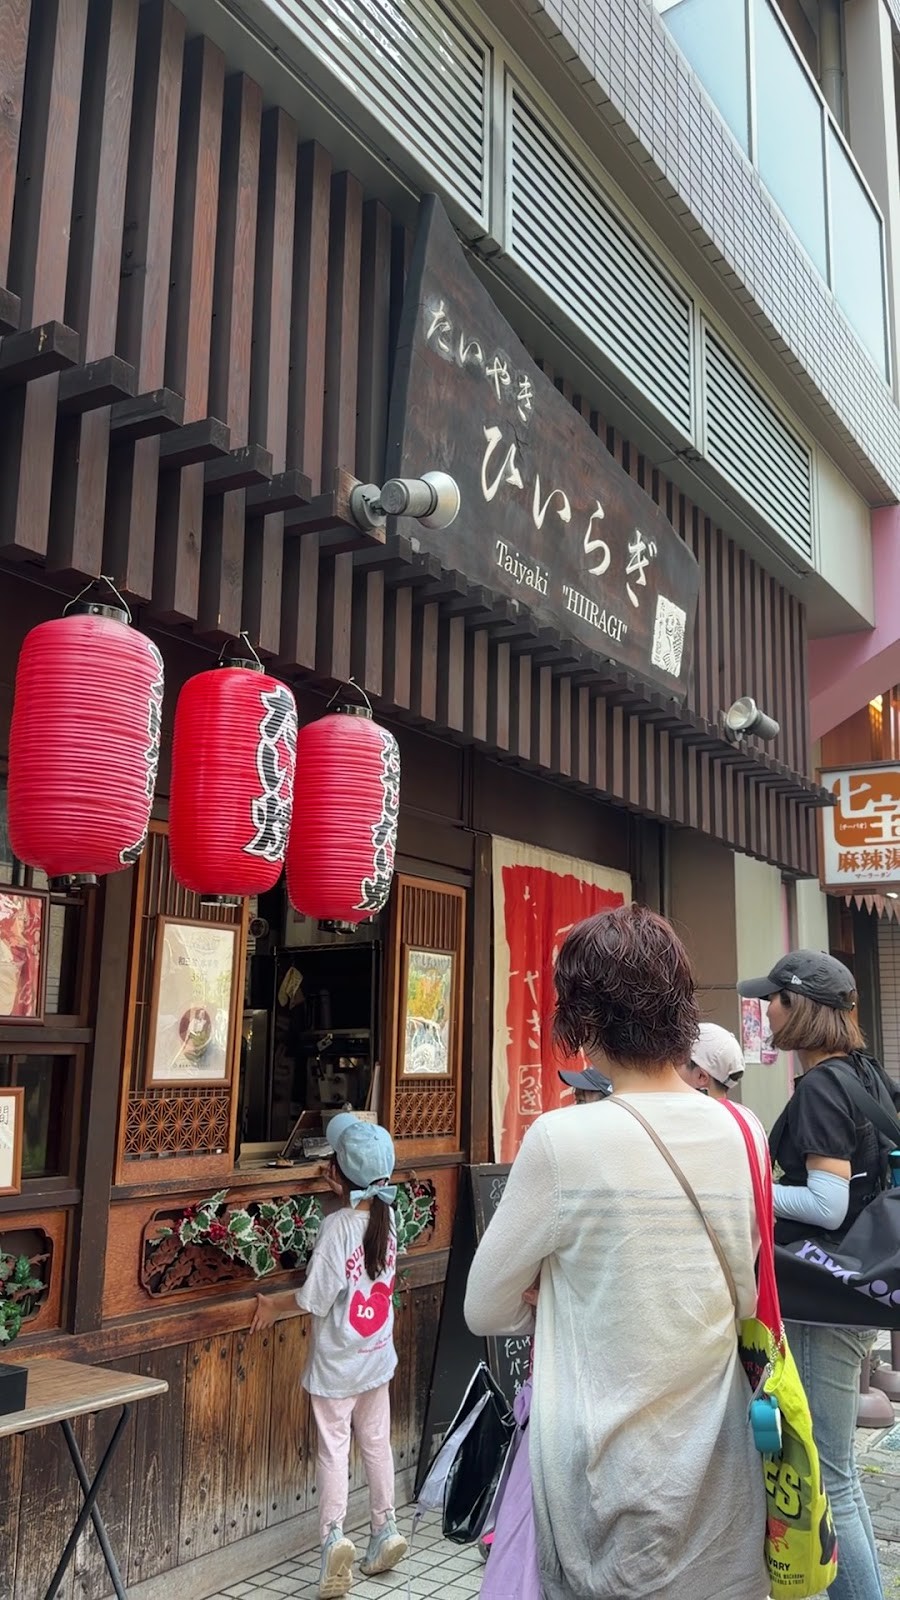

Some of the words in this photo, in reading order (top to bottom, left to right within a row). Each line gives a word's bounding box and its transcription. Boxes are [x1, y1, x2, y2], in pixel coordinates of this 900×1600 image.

[426, 300, 535, 422] たいやき
[481, 426, 658, 608] ひいらぎ
[496, 539, 548, 597] Taiyaki
[563, 584, 628, 643] "HIIRAGI"
[356, 1304, 375, 1320] LO
